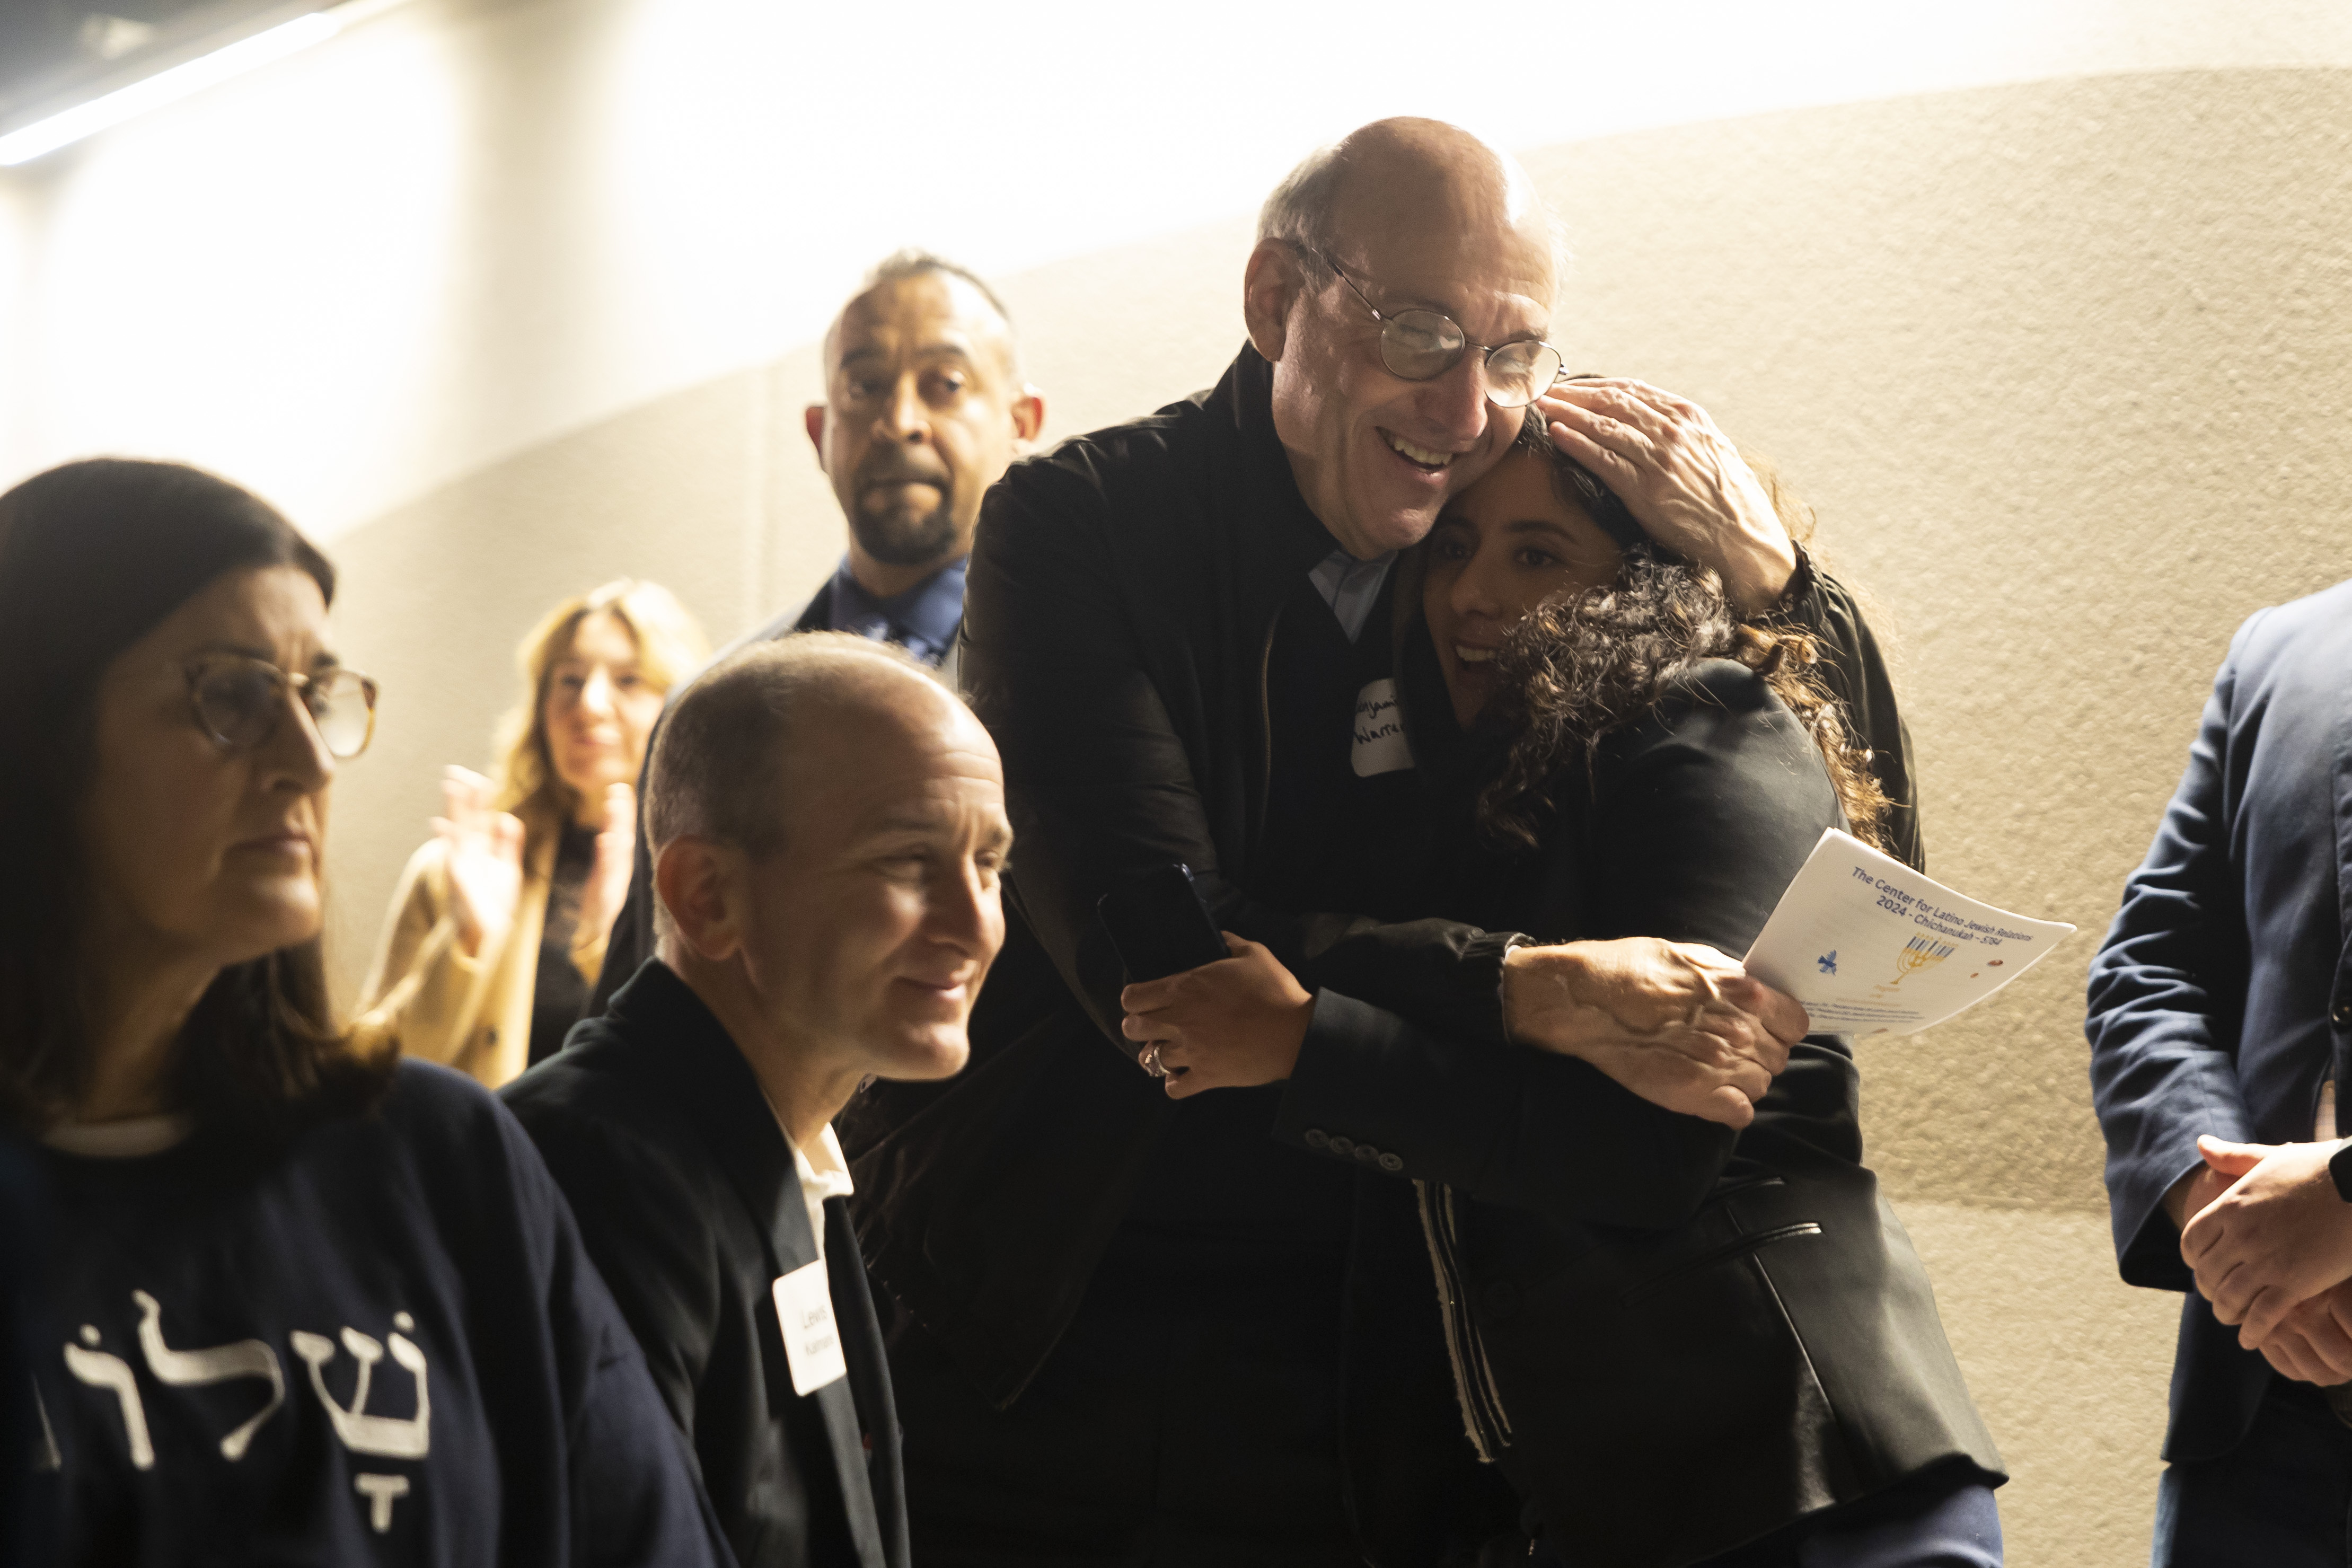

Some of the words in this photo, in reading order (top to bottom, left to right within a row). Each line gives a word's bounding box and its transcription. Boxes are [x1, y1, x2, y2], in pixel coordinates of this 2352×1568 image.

[1852, 866, 1874, 884] The
[1875, 878, 1915, 905] Center
[1915, 898, 1934, 913] for
[1933, 906, 1964, 926] Latino
[1963, 919, 1995, 935] Jewish
[1994, 928, 2034, 941] Relations
[1877, 895, 1907, 917] 2024
